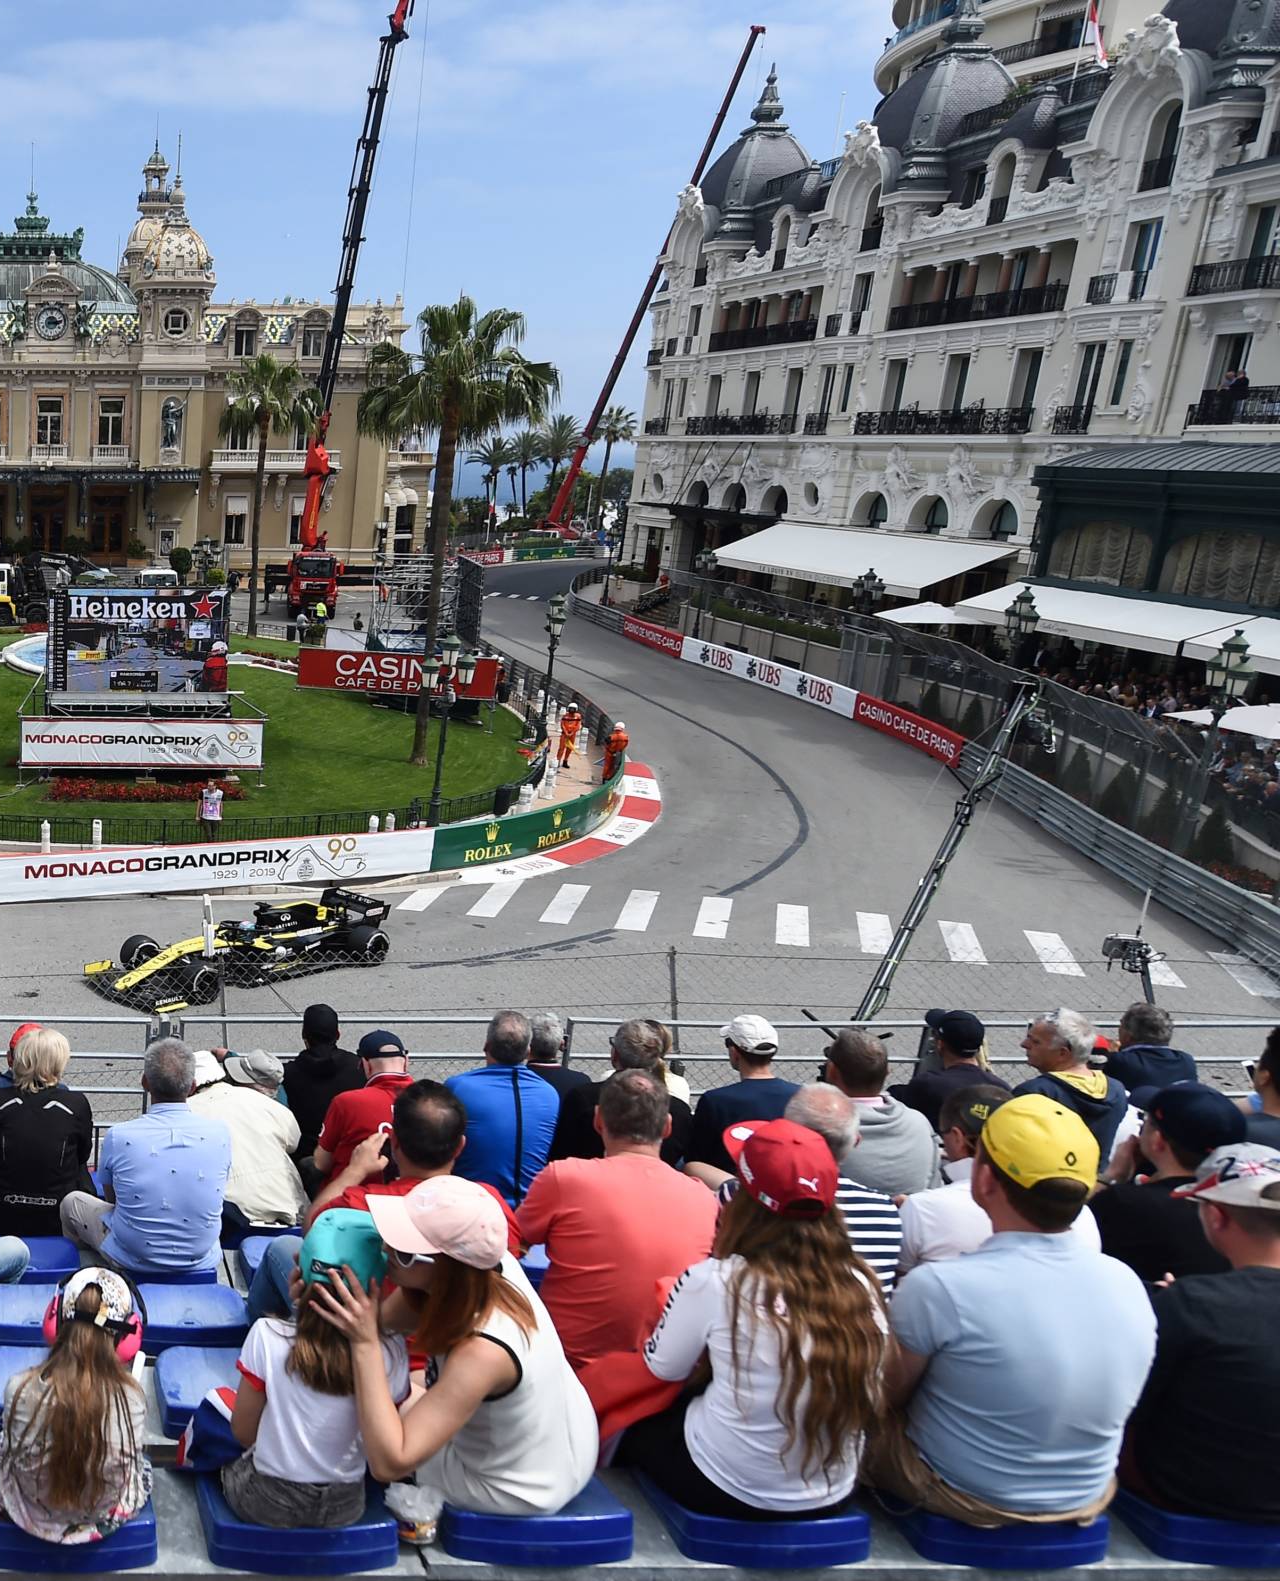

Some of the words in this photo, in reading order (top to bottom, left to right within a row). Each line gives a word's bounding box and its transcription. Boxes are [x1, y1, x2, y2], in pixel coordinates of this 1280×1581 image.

[70, 596, 186, 618] Heineken
[336, 654, 457, 681] CASIN
[711, 648, 733, 671] UBS
[334, 676, 377, 688] CAFE
[381, 681, 402, 691] DE
[758, 662, 782, 687] UBS
[809, 679, 834, 705] UBS
[25, 734, 202, 746] MONACOGRANDPRIX
[228, 731, 248, 746] 90
[858, 702, 893, 726] CASINO
[893, 716, 915, 738] CAFE
[916, 726, 929, 745] DE
[929, 733, 956, 758] PARIS
[327, 836, 357, 861] 90
[537, 828, 571, 848] ROLEX
[464, 843, 512, 862] ROLEX
[24, 849, 291, 880] MONACOGRANDPRIX
[212, 870, 238, 880] 1929
[249, 867, 276, 878] 2019
[514, 859, 553, 873] UBS
[155, 995, 184, 1006] RENAULT
